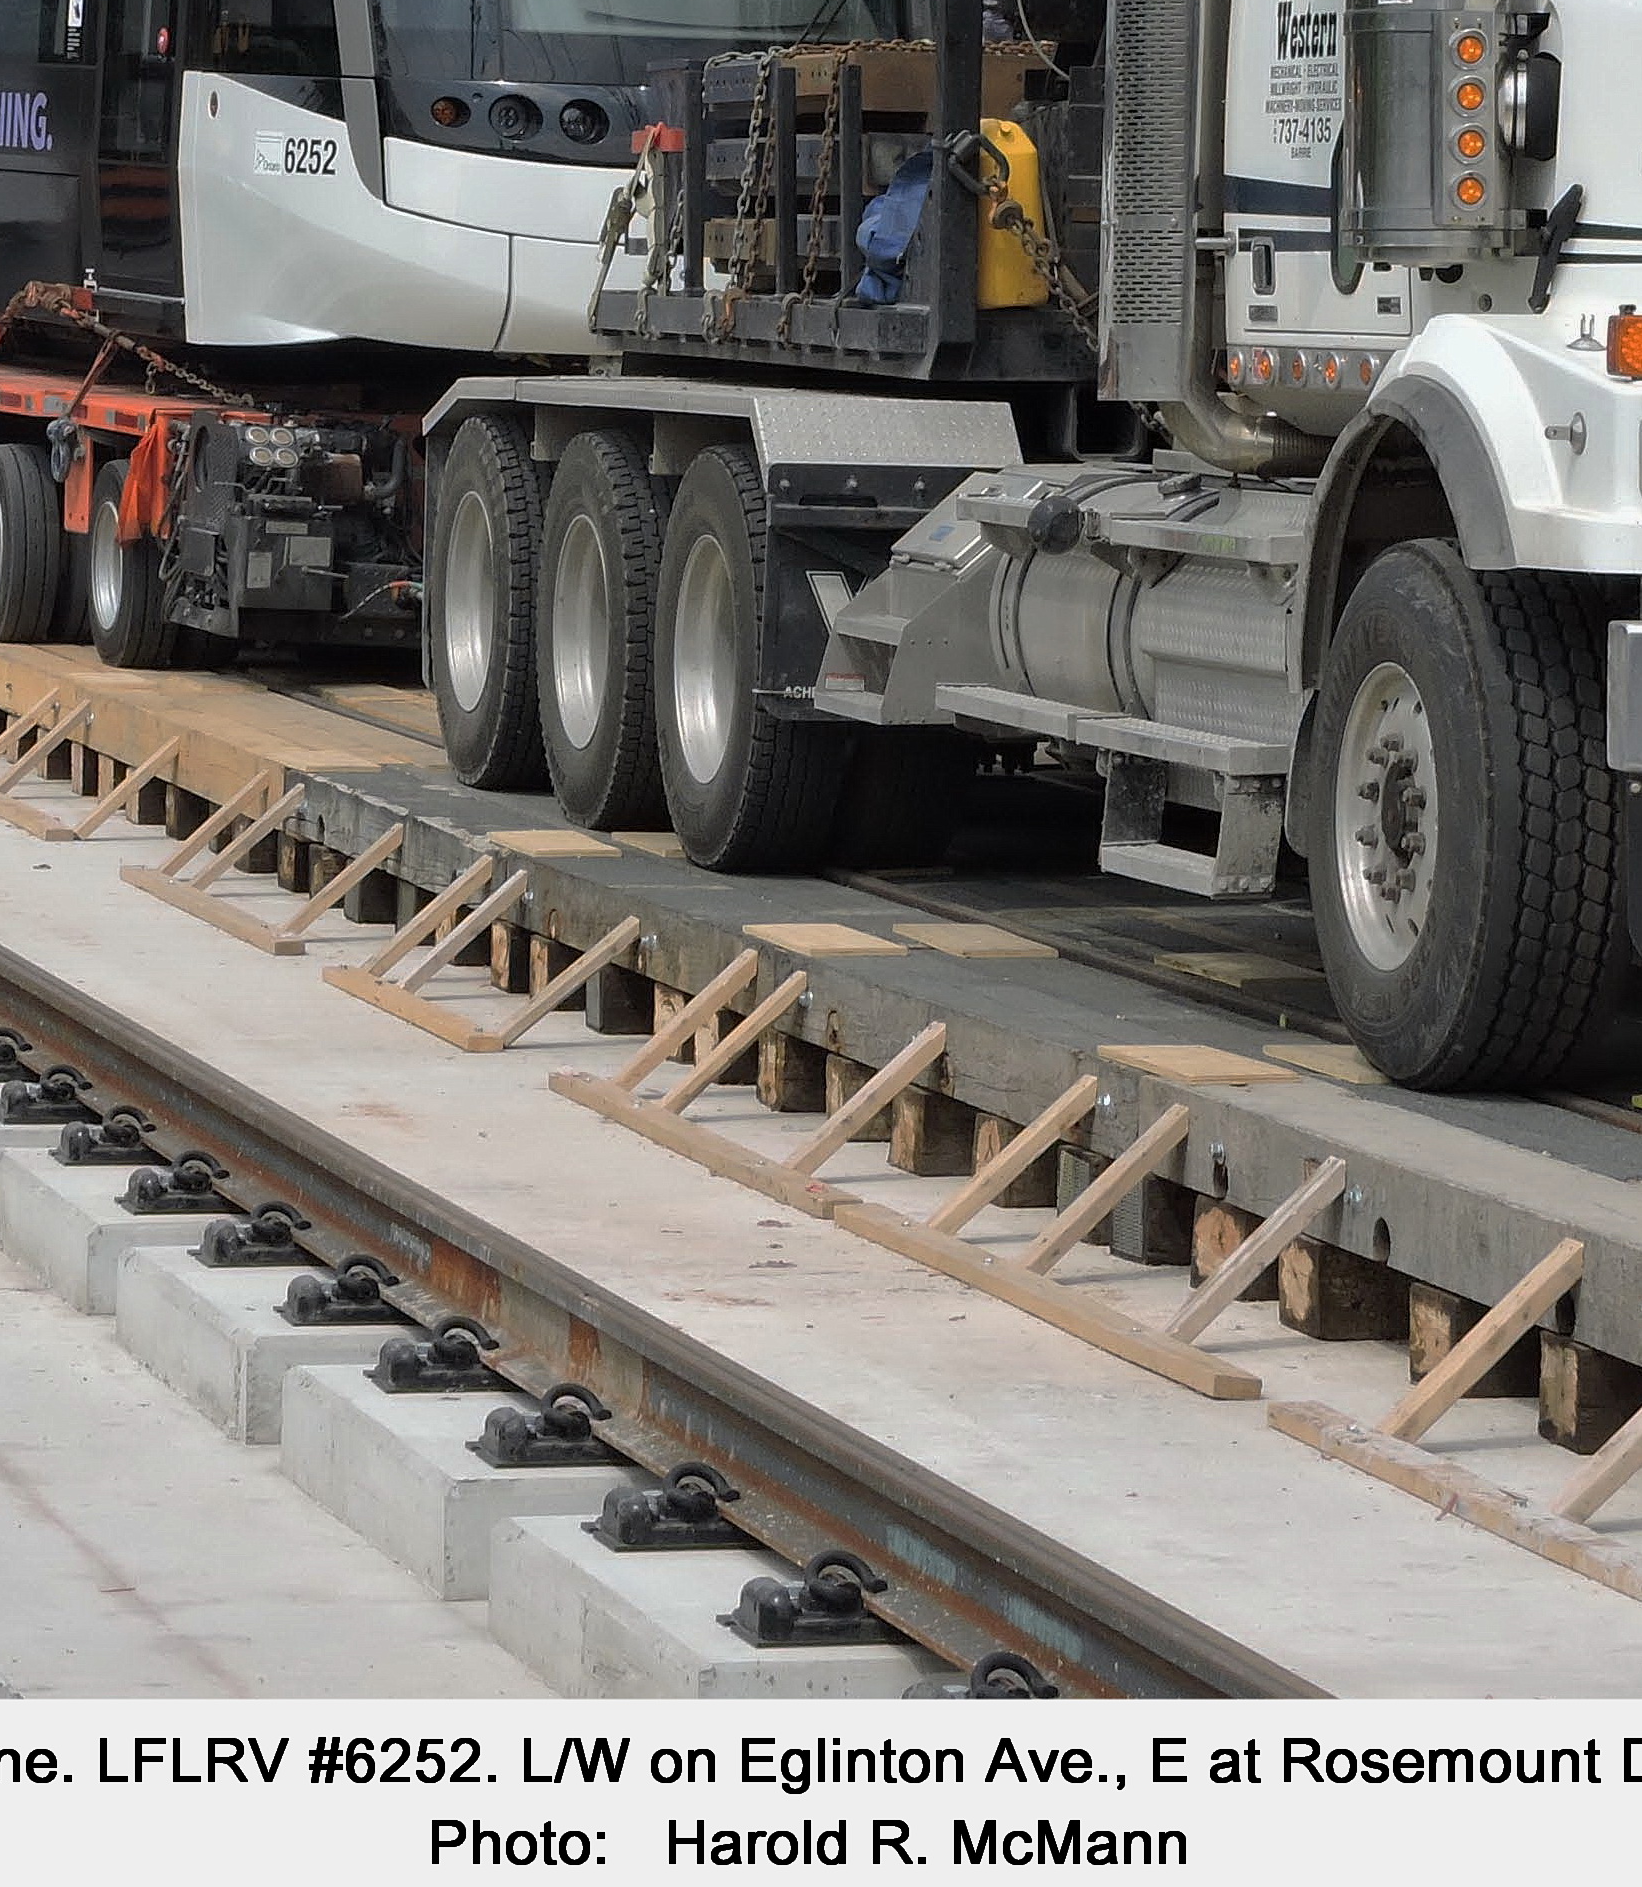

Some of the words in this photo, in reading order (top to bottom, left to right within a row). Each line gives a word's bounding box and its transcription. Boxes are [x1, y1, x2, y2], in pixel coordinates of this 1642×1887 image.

[1276, 0, 1338, 61] Western
[1278, 117, 1331, 144] 737-4135
[284, 138, 338, 175] 6252
